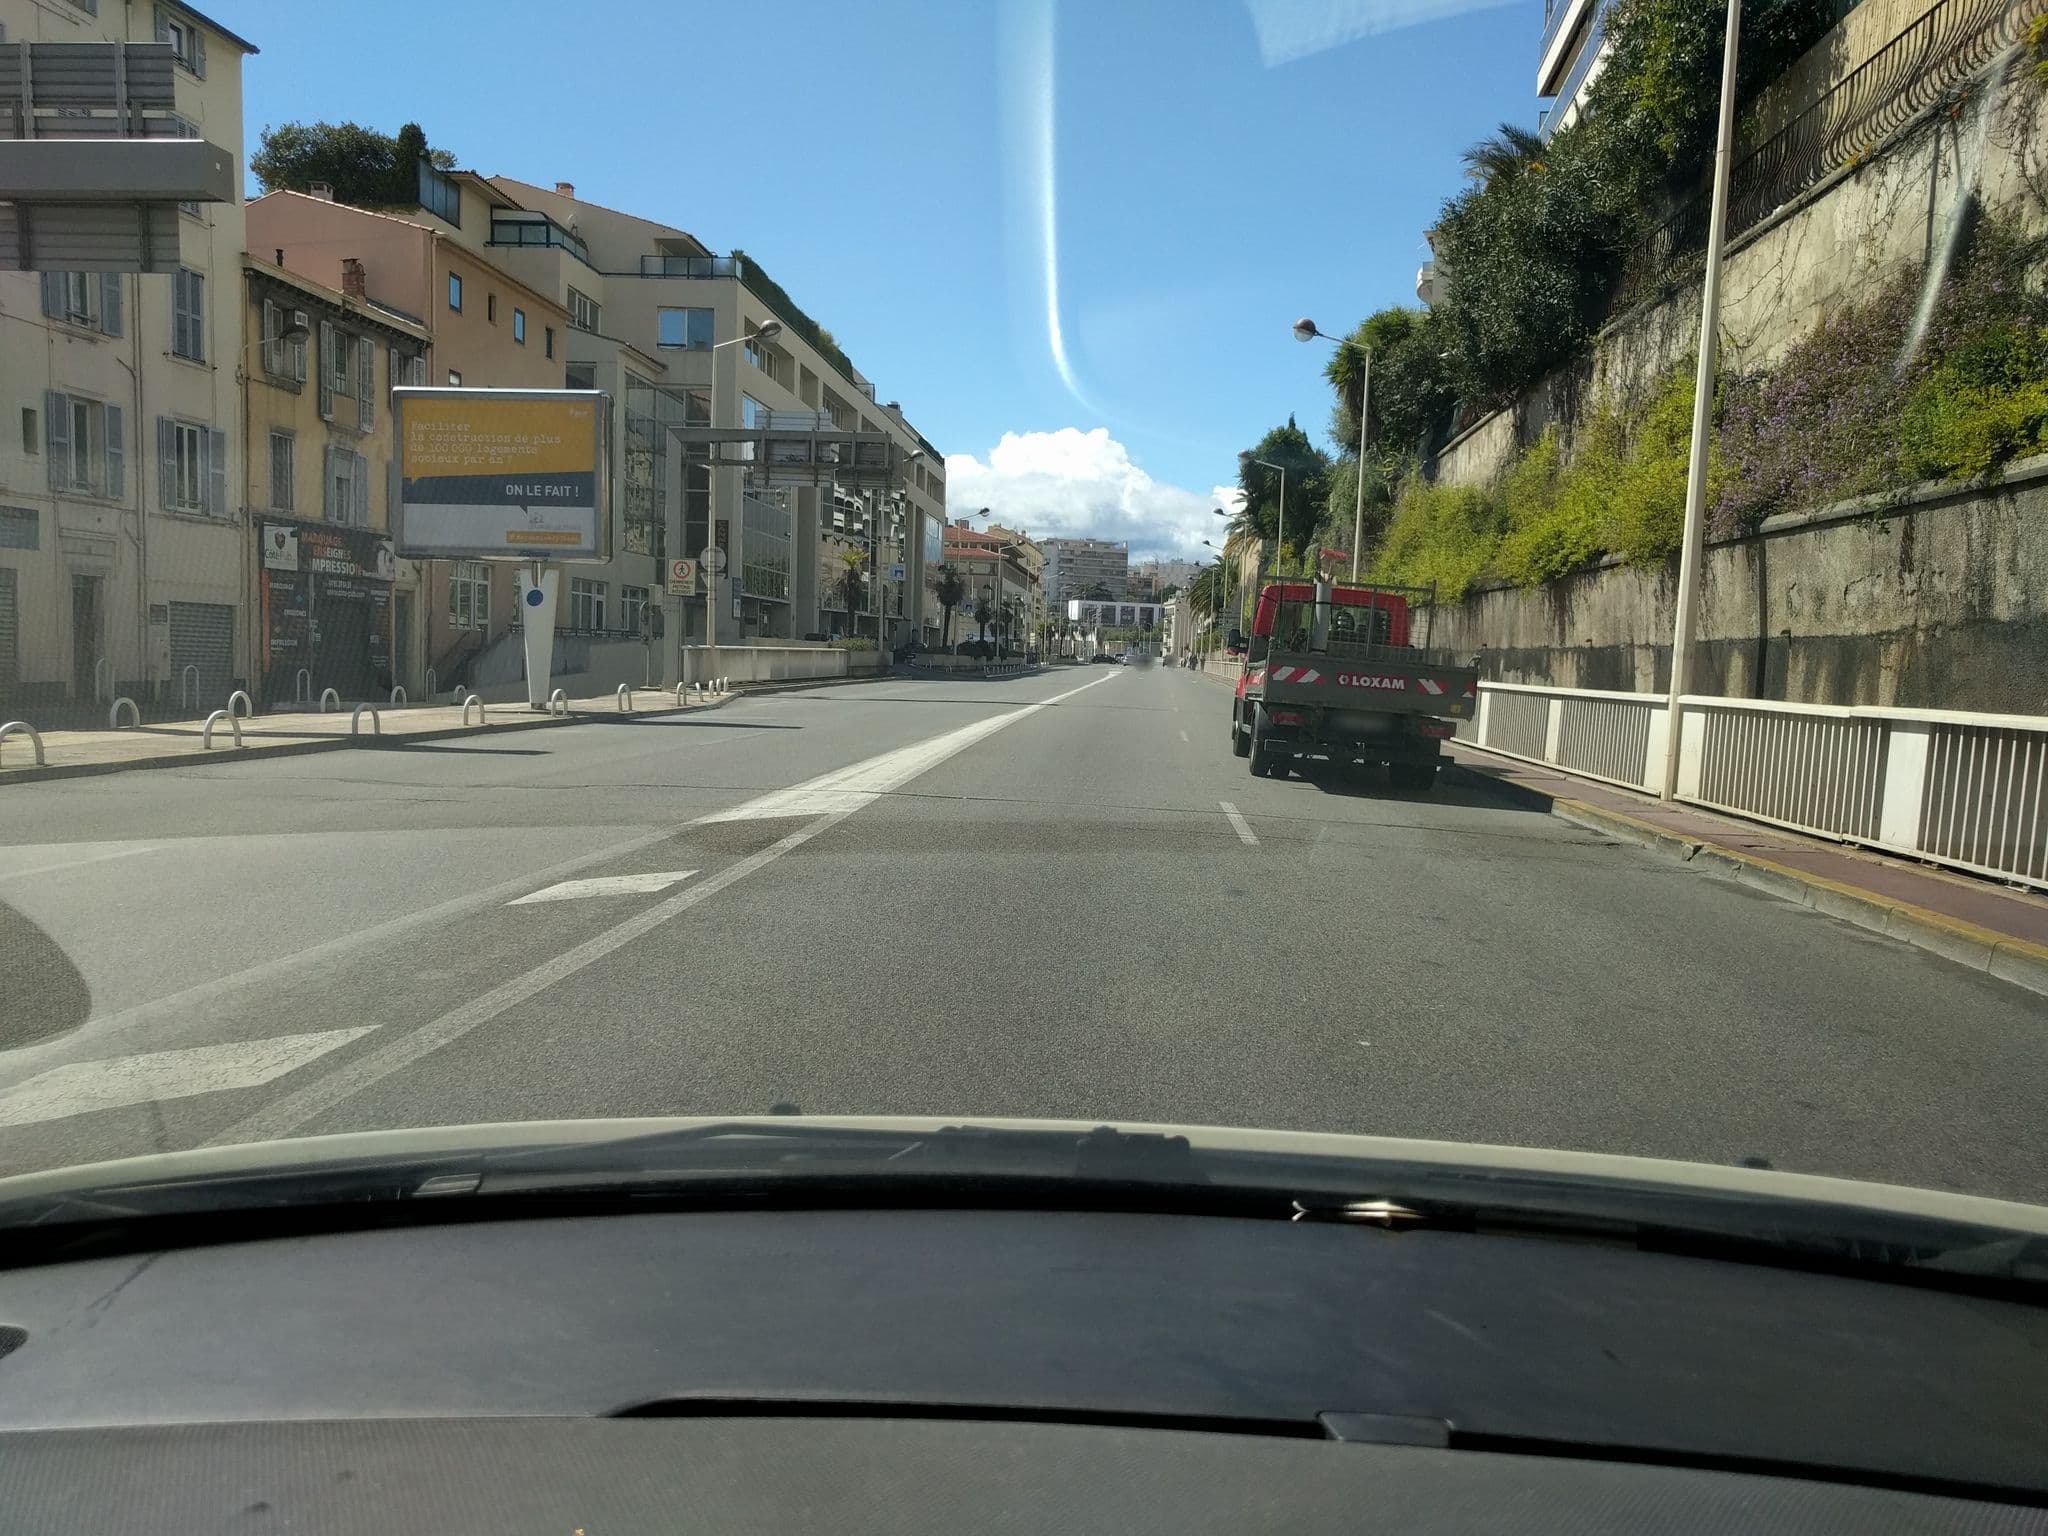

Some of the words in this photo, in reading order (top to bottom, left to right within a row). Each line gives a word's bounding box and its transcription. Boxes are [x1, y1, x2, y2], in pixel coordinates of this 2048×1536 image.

[410, 432, 424, 441] la
[429, 433, 511, 442] construction
[515, 434, 528, 443] de
[533, 435, 560, 445] plus
[410, 443, 424, 452] de
[477, 444, 538, 456] logements
[411, 454, 458, 464] sociaux
[464, 456, 484, 465] par
[489, 456, 504, 464] an
[506, 484, 523, 496] ON
[526, 485, 542, 496] LE
[545, 485, 571, 497] FAIT
[1352, 675, 1405, 690] LOXAM
